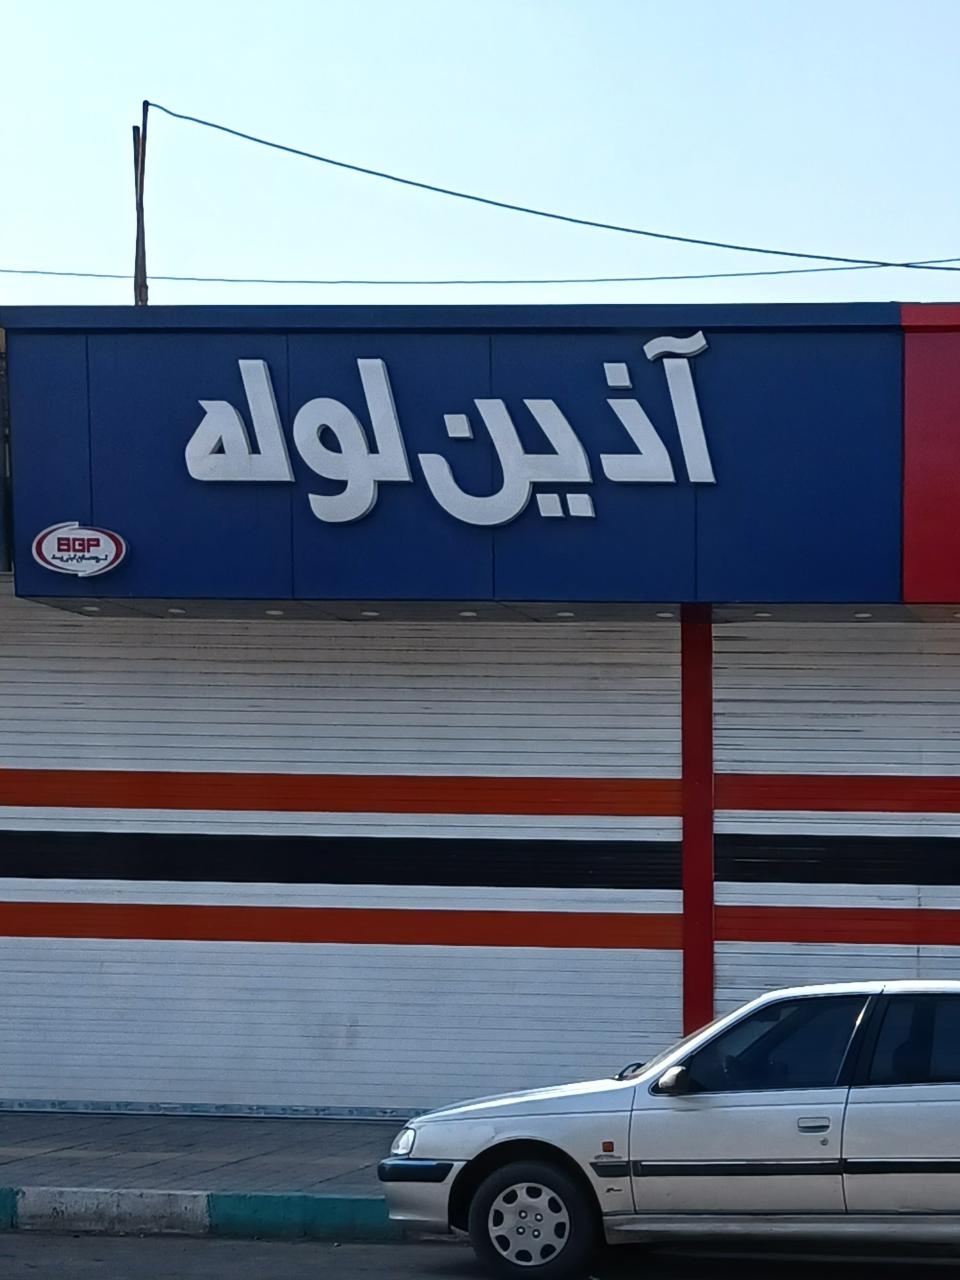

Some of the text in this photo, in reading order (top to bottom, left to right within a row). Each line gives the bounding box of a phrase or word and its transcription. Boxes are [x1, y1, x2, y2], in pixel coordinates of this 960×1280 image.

[184, 330, 716, 526] آذین لوله
[57, 537, 100, 553] BGP
